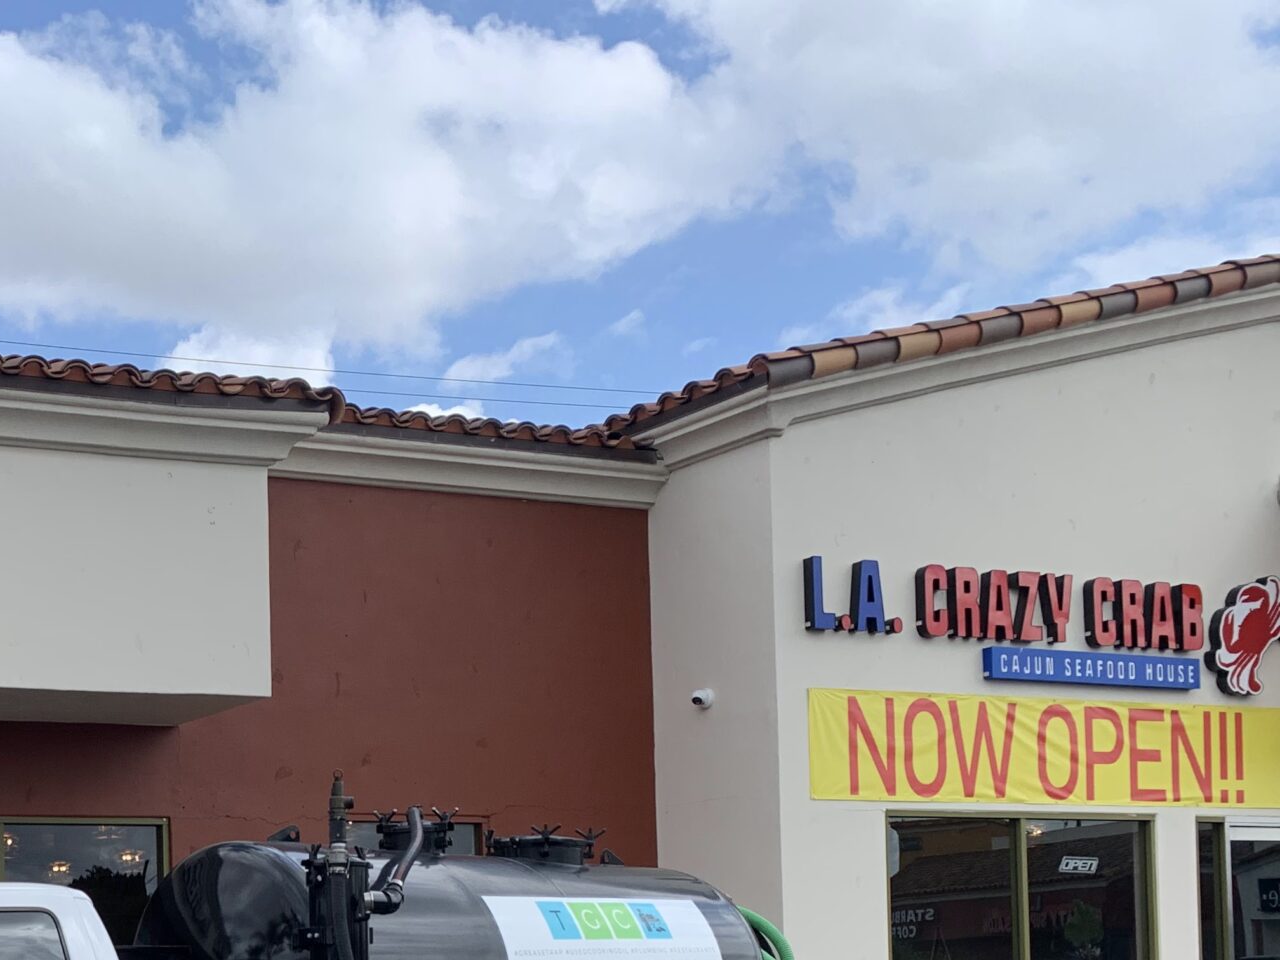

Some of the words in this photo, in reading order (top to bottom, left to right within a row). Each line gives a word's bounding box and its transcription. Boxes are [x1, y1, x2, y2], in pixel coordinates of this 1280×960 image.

[803, 555, 903, 634] L.A.
[915, 563, 1073, 644] CRAZY
[1083, 576, 1205, 651] CRAB
[1000, 654, 1055, 675] CAJUN
[1064, 658, 1136, 680] SEAFOOD
[1145, 663, 1195, 684] HOUSE
[847, 695, 1018, 799] NOW
[1036, 703, 1245, 804] OPEN!!
[1061, 859, 1097, 872] OPEN
